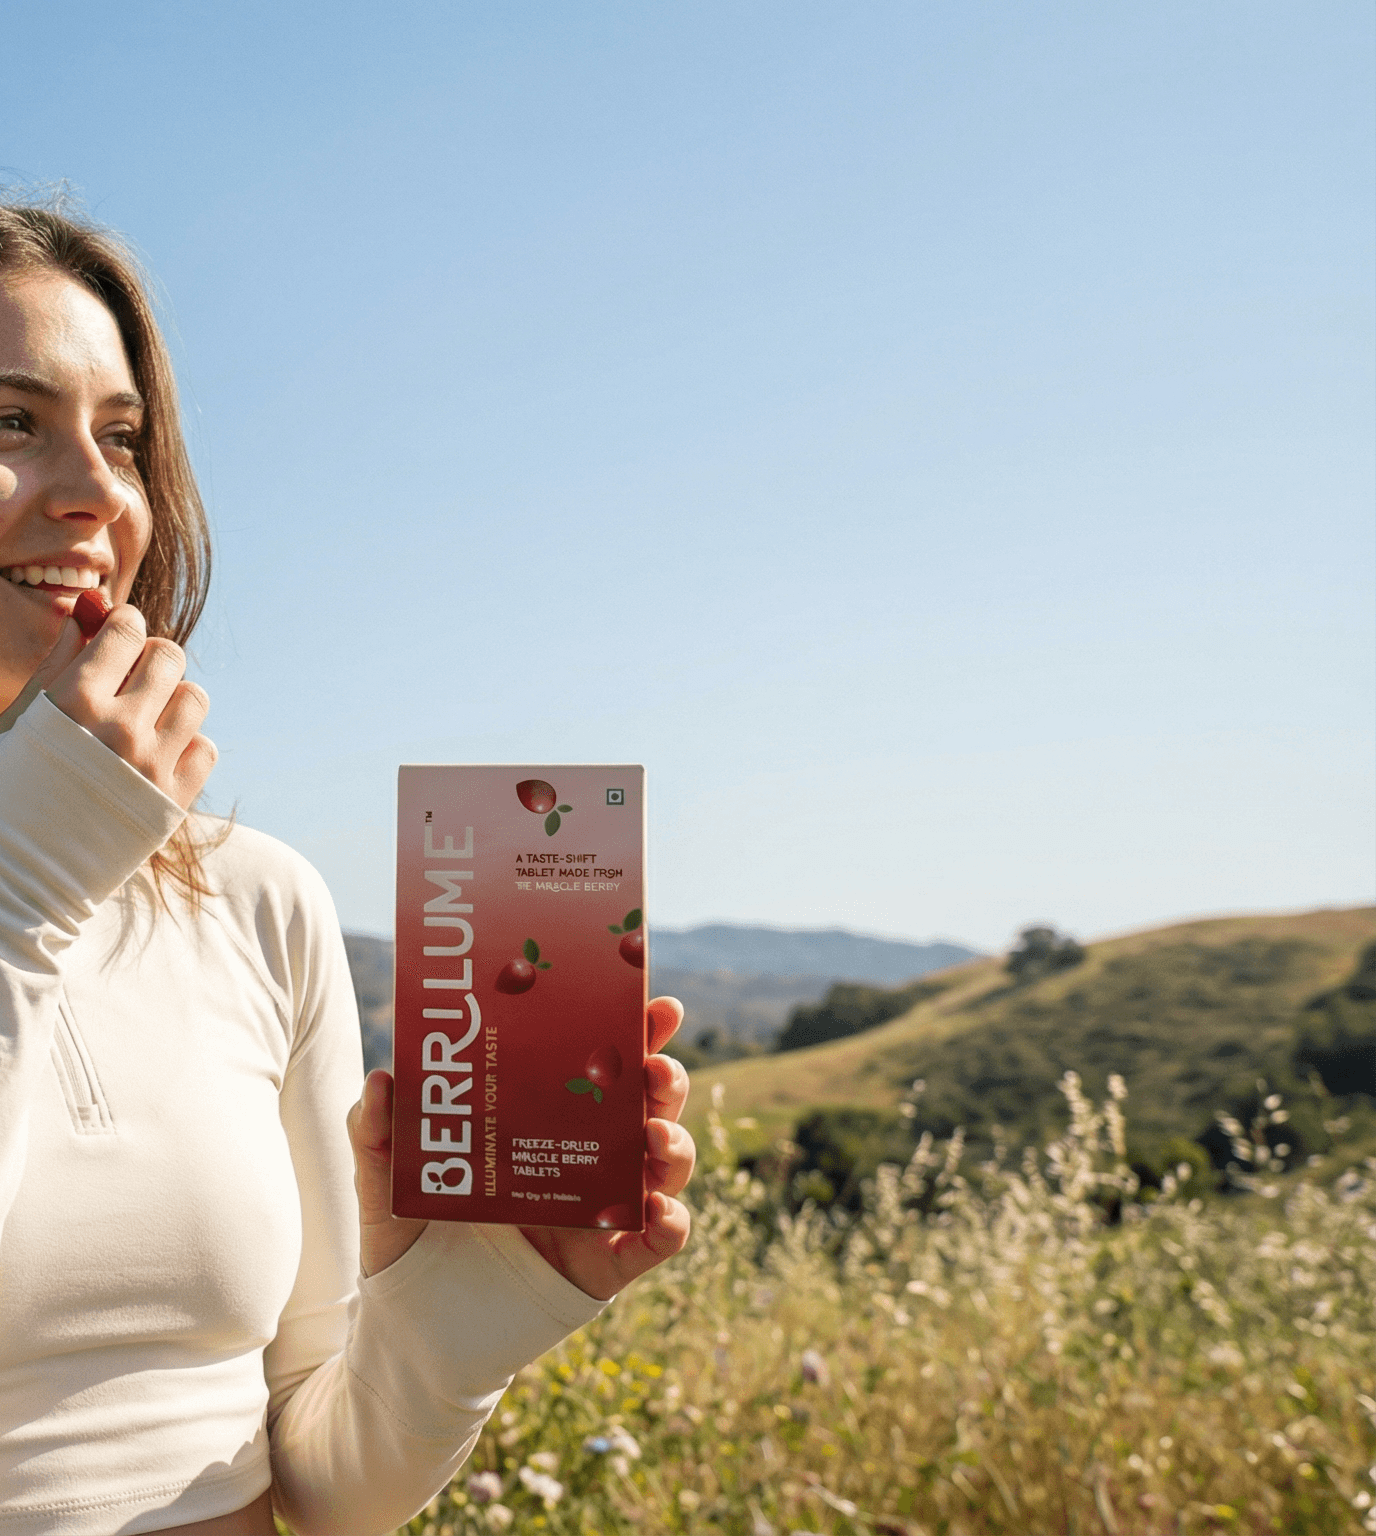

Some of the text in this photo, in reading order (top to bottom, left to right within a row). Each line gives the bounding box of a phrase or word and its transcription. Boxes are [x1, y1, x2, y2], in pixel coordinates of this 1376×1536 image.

[515, 853, 523, 864] A
[515, 867, 555, 877] TABLET
[559, 868, 590, 878] MADE
[420, 825, 482, 1196] BERRILUME
[485, 1026, 498, 1197] ILLUMINATE YOUR TASTE
[512, 1137, 600, 1152] FREEZE-DRIED
[561, 1153, 600, 1165] BERRY
[512, 1165, 561, 1178] TABLETS
